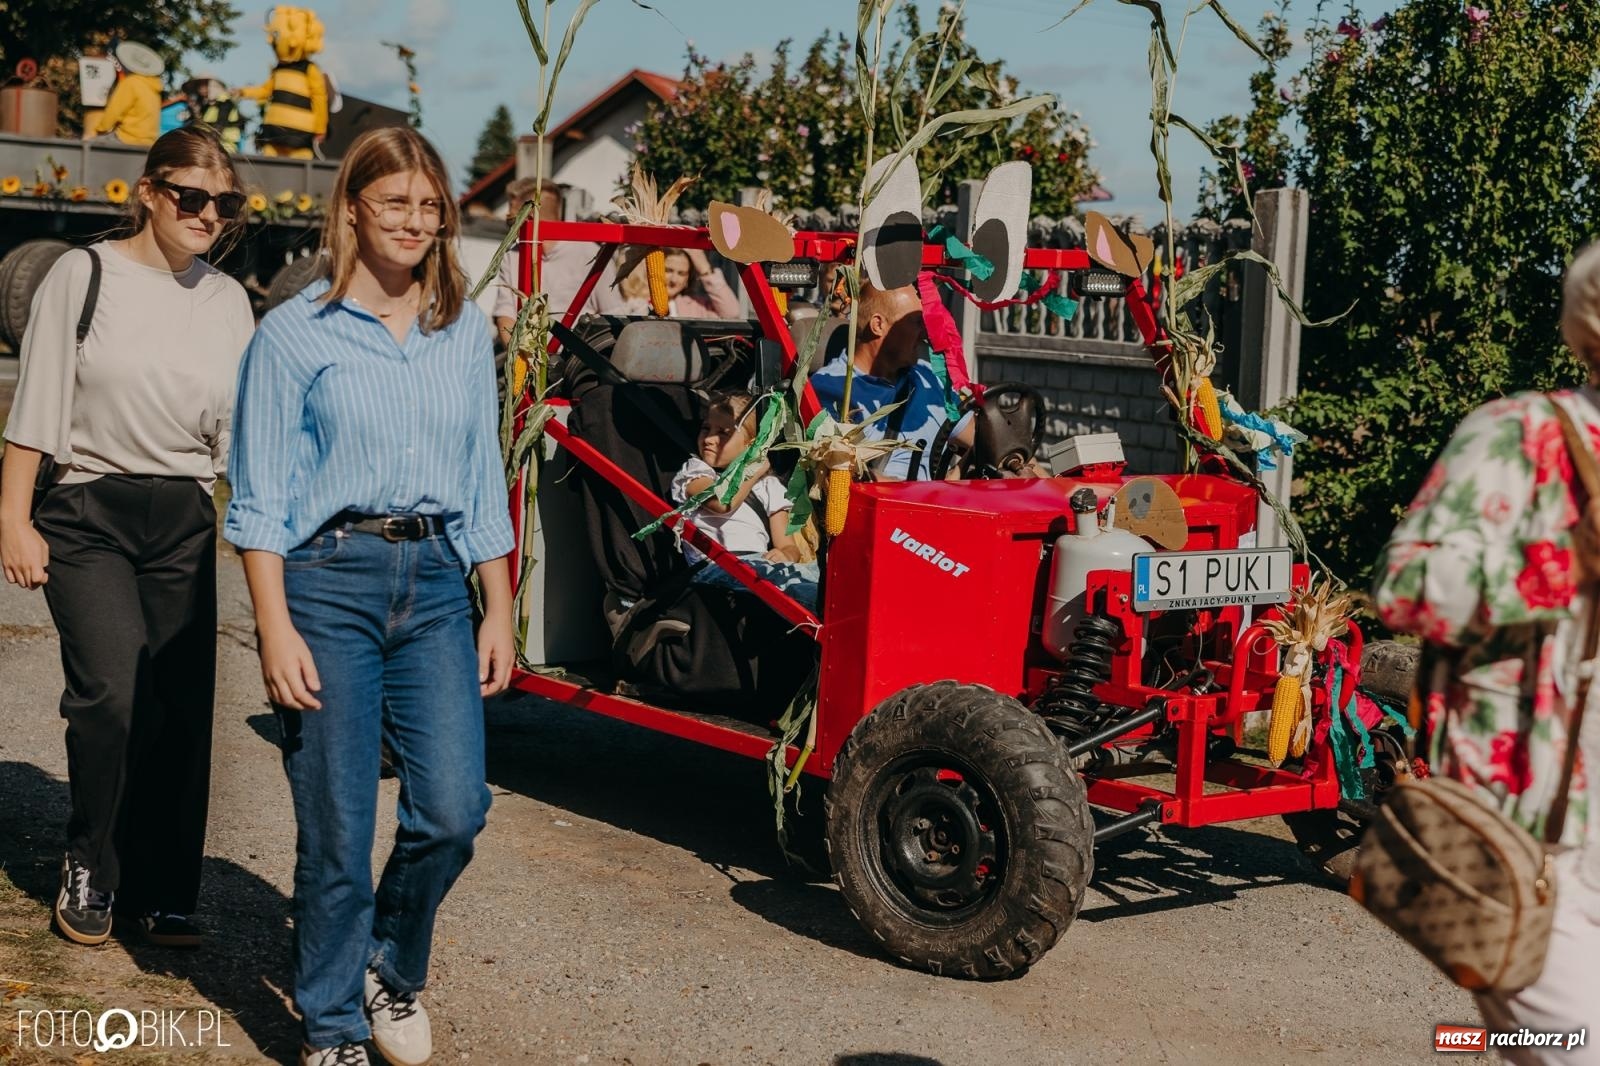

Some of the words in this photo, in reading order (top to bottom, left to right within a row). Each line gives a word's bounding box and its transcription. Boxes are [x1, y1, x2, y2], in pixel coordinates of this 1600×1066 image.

[1156, 559, 1187, 596] S1
[1205, 555, 1272, 594] PUKI
[1138, 584, 1147, 594] PL
